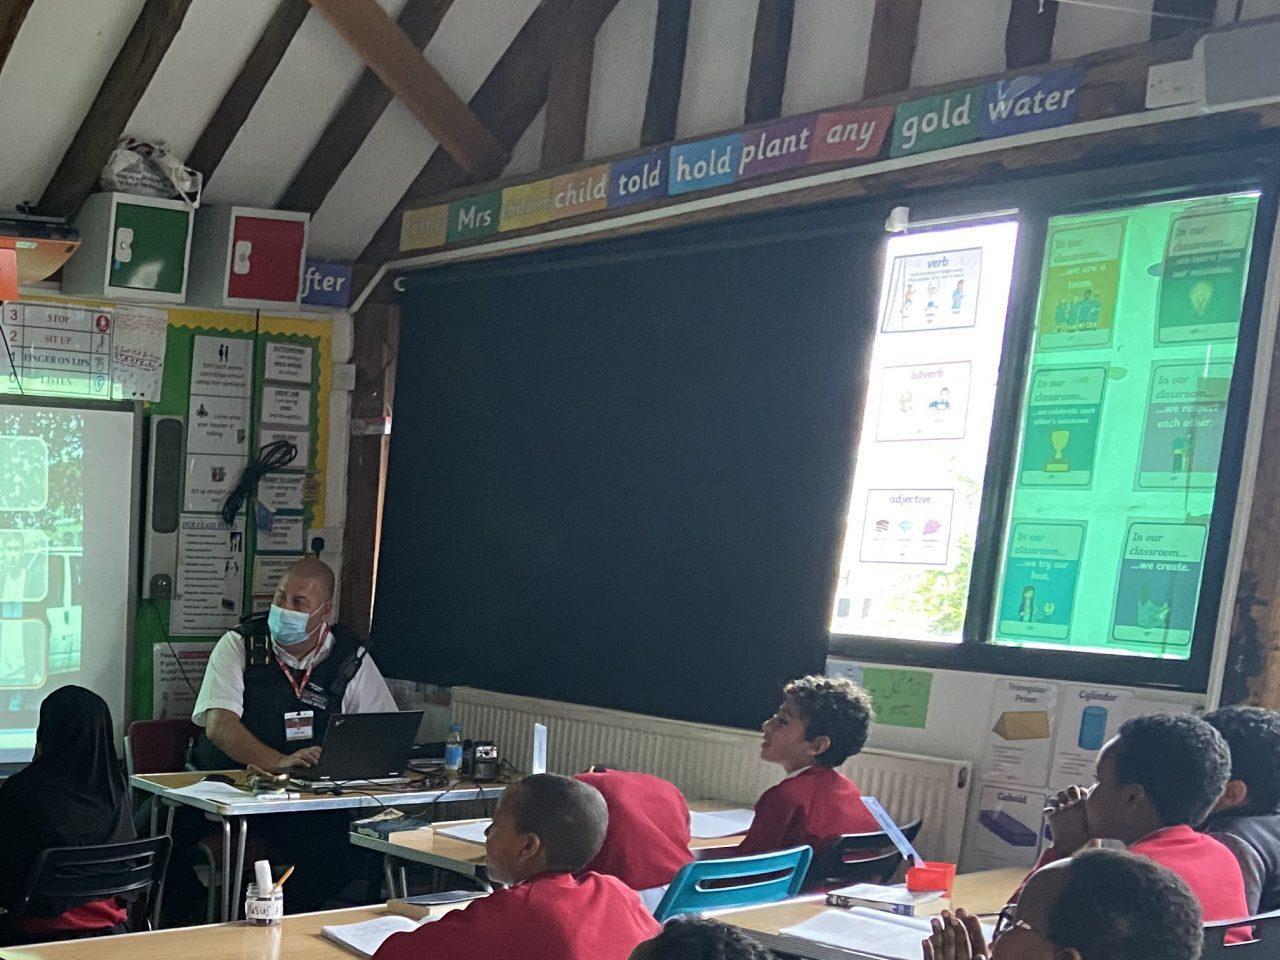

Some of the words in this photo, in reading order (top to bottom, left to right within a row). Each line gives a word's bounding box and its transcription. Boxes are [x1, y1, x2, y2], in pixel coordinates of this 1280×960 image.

[457, 205, 492, 231] Mrs
[554, 174, 607, 208] child
[618, 159, 662, 195] told
[676, 146, 731, 182] hold
[737, 127, 810, 176] plant
[826, 119, 877, 151] any
[902, 94, 971, 149] gold
[988, 87, 1076, 123] water
[927, 255, 949, 269] verb
[300, 266, 347, 298] fter
[10, 309, 18, 321] 3
[47, 313, 71, 324] STOP
[10, 330, 18, 342] 2
[45, 334, 60, 344] SIT
[24, 352, 57, 364] FINGER
[57, 356, 70, 365] ON
[72, 357, 90, 368] LIPS
[889, 493, 933, 507] adjective
[1132, 532, 1143, 542] In
[1145, 534, 1163, 542] our
[1155, 562, 1190, 572] create.
[1078, 690, 1120, 702] Cylinder
[996, 791, 1027, 804] Cuboid
